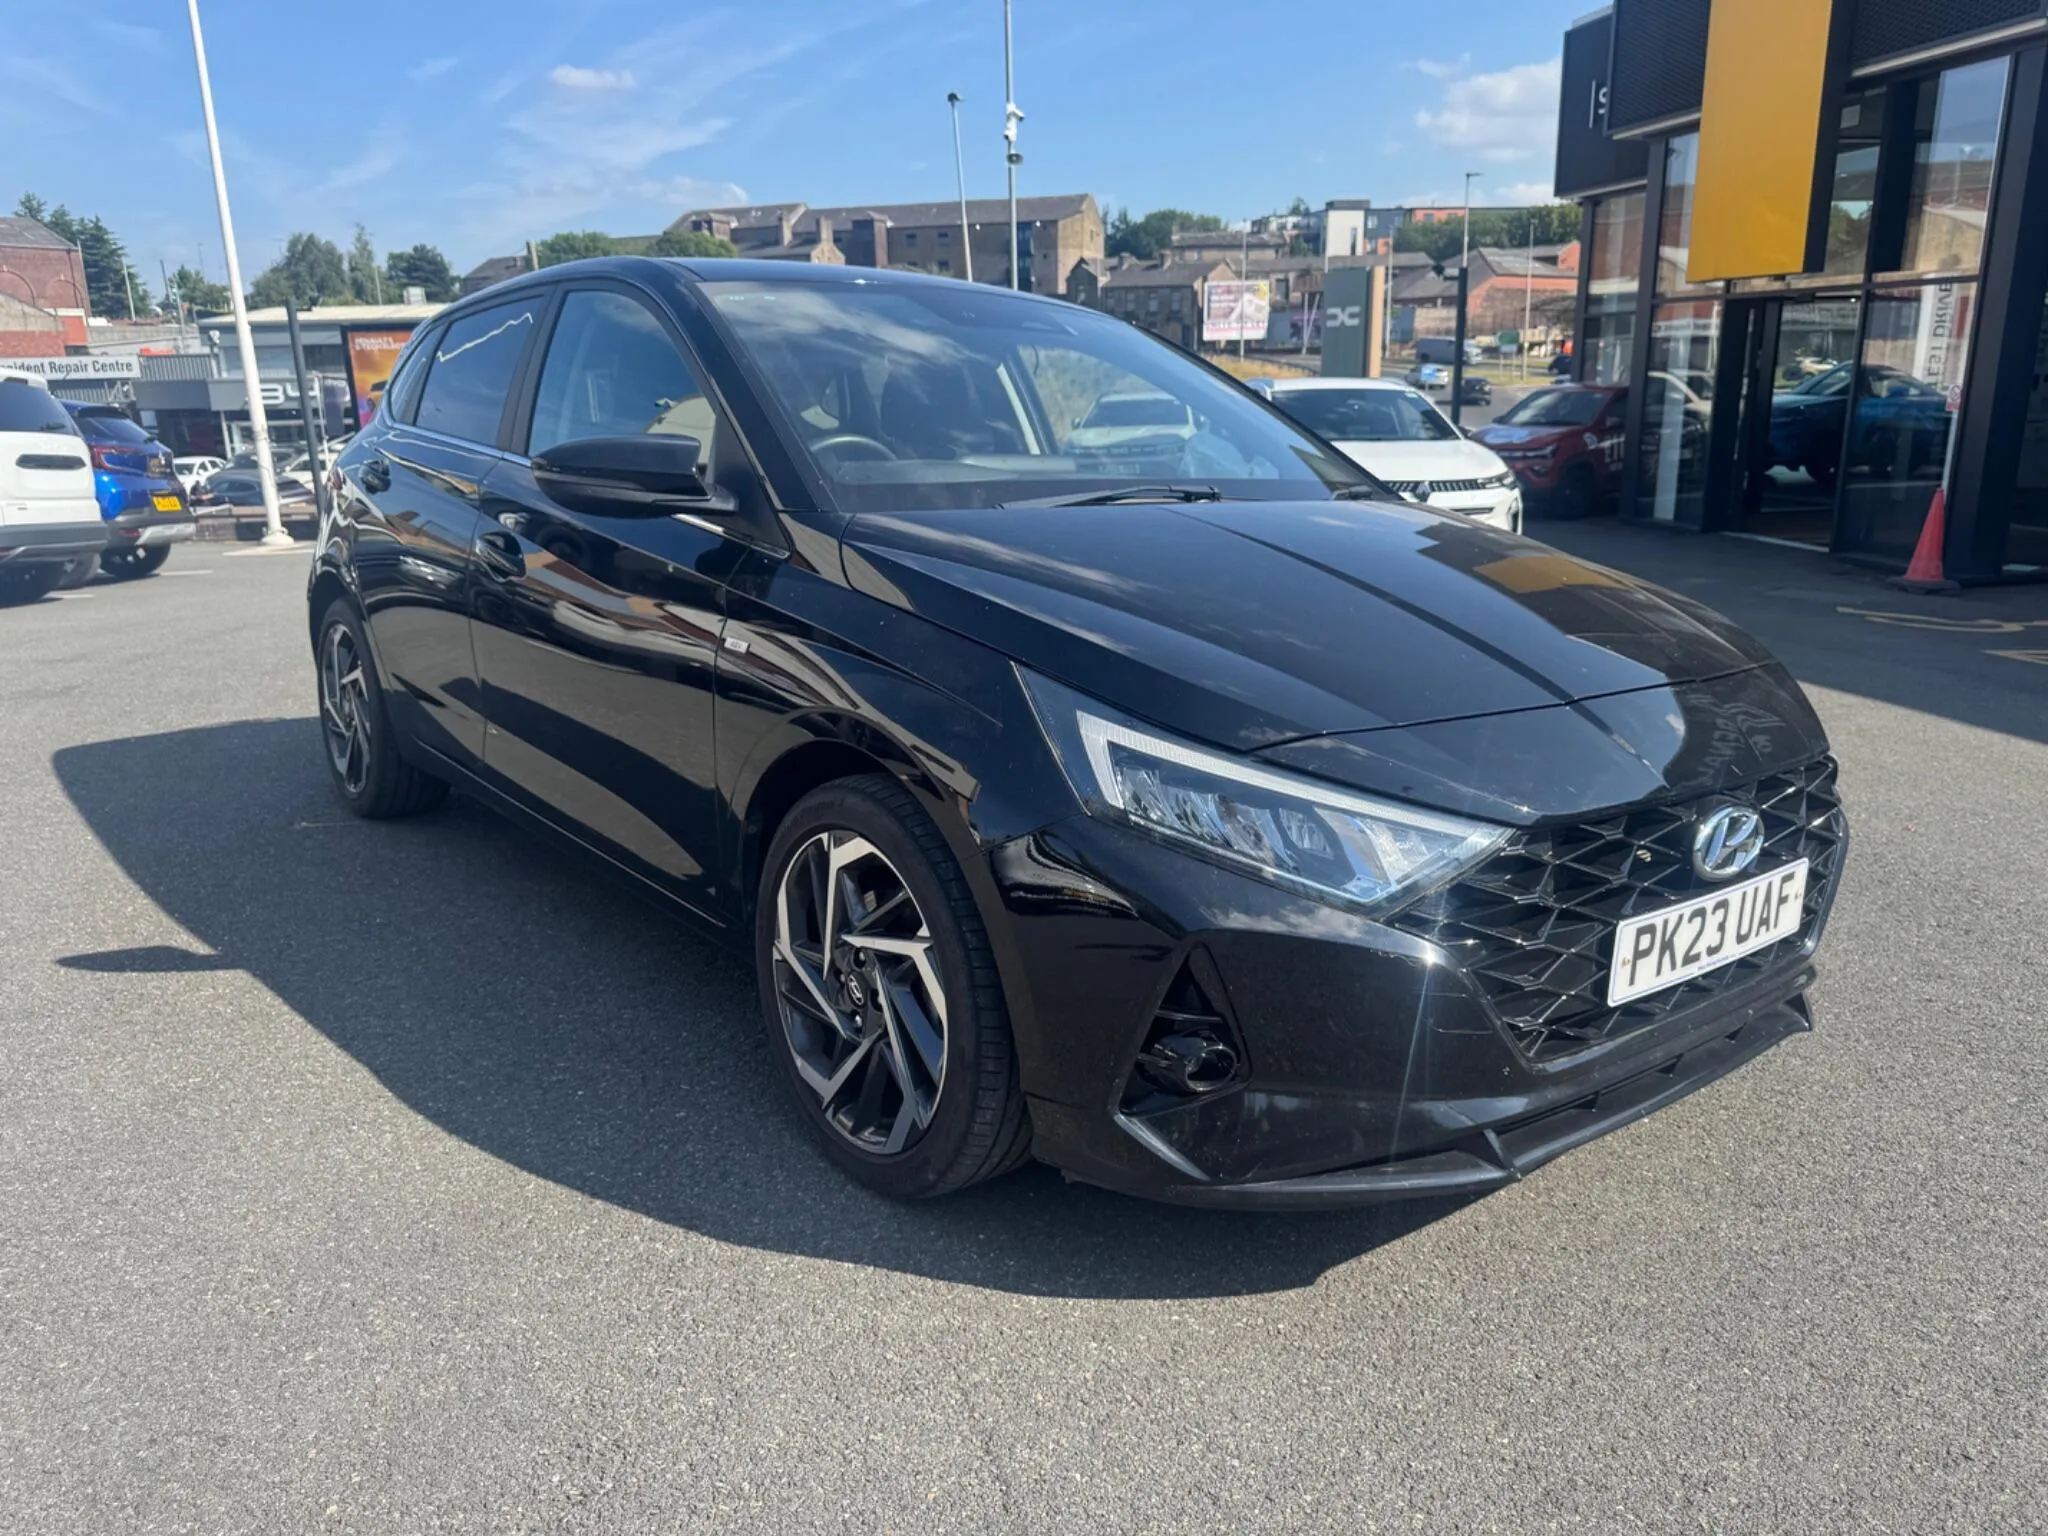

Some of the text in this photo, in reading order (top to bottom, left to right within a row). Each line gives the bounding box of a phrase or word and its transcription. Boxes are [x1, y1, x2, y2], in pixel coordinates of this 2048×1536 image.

[0, 360, 133, 376] ident Repair Centre
[258, 382, 350, 404] BY
[1628, 871, 1795, 986] PK23 UAF
